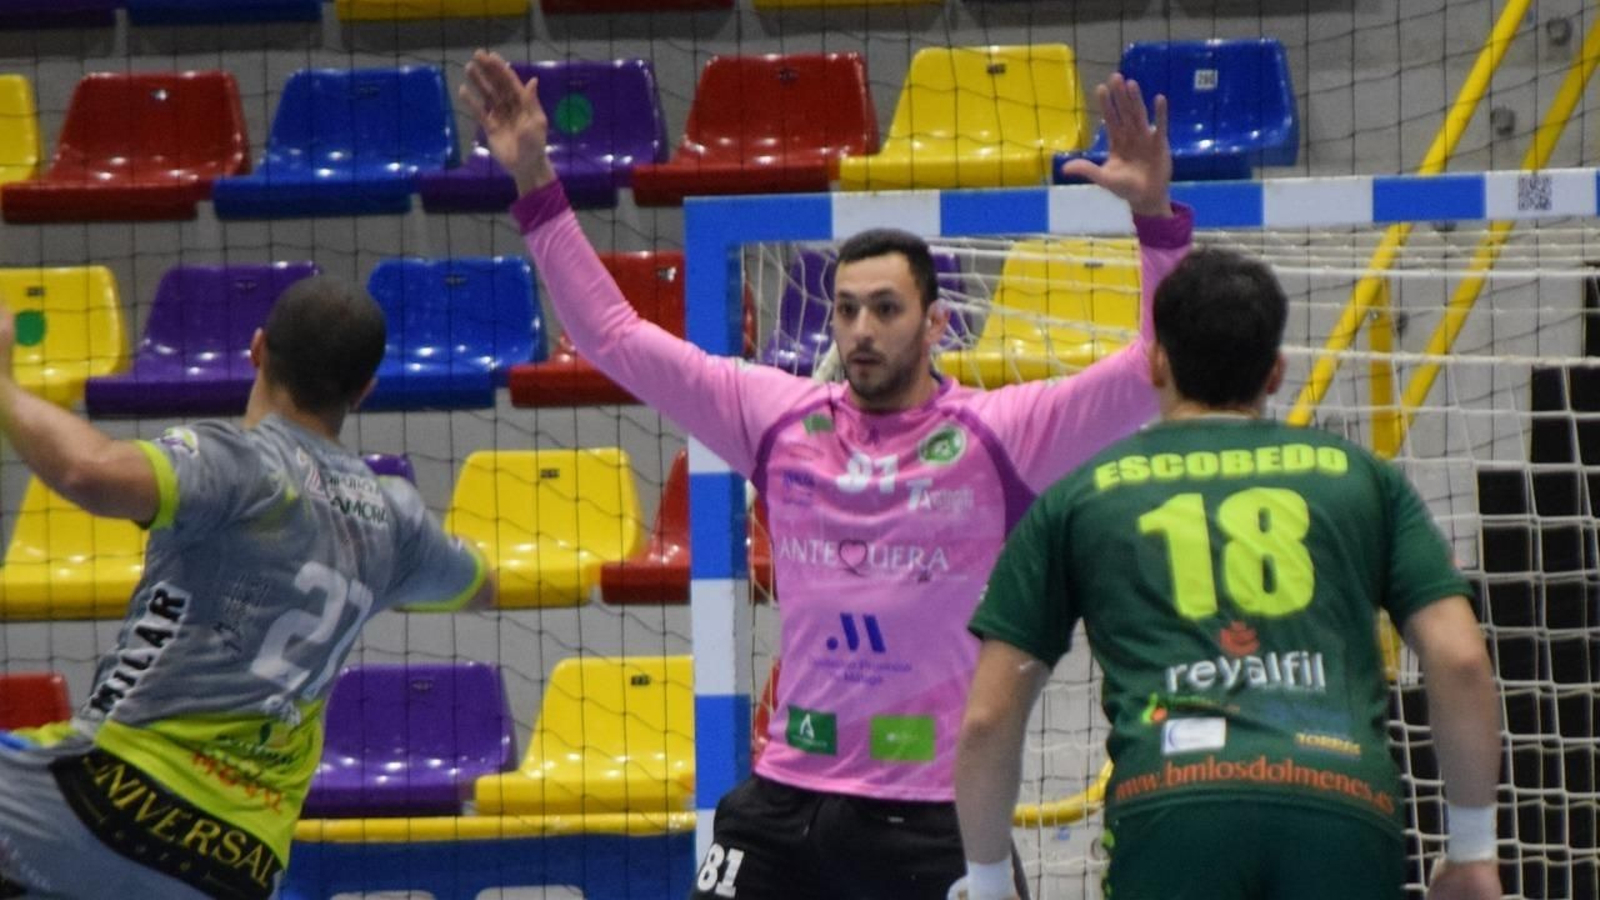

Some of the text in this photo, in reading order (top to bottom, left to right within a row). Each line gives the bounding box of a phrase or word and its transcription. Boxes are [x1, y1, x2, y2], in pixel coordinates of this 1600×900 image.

[1094, 443, 1348, 491] ESCOBEDO
[1137, 486, 1316, 620] 18
[251, 561, 374, 699] 27
[1165, 650, 1327, 694] reyalfil
[697, 842, 745, 898] 81
